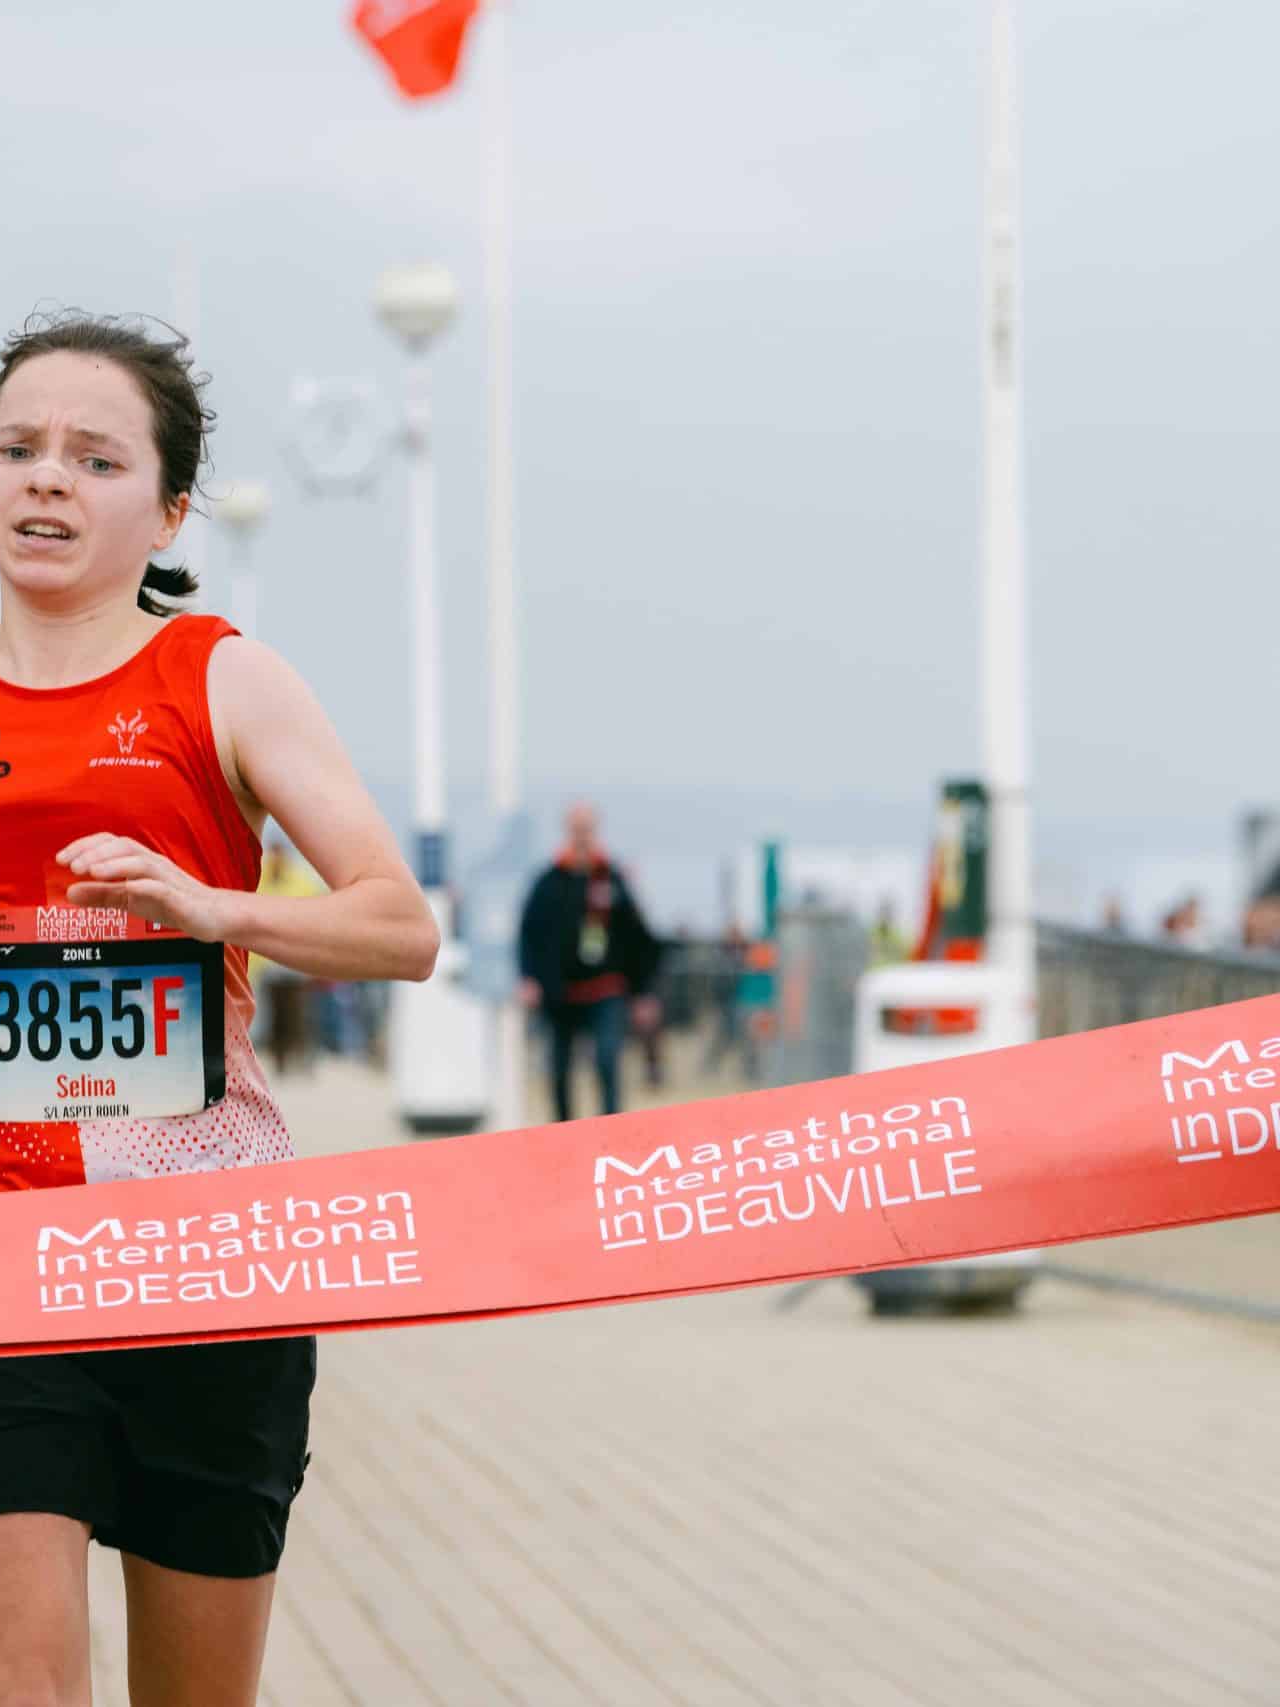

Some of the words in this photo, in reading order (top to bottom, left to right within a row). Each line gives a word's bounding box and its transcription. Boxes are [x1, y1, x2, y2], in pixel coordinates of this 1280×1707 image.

[63, 948, 93, 961] ZONE
[95, 947, 102, 961] 1
[56, 1073, 116, 1099] Selina
[63, 1104, 92, 1119] ASPTT
[96, 1102, 129, 1117] ROUEN
[593, 1096, 968, 1186] Marathon
[595, 1113, 973, 1210] International
[36, 1191, 413, 1252] Marathon
[37, 1212, 417, 1277] International
